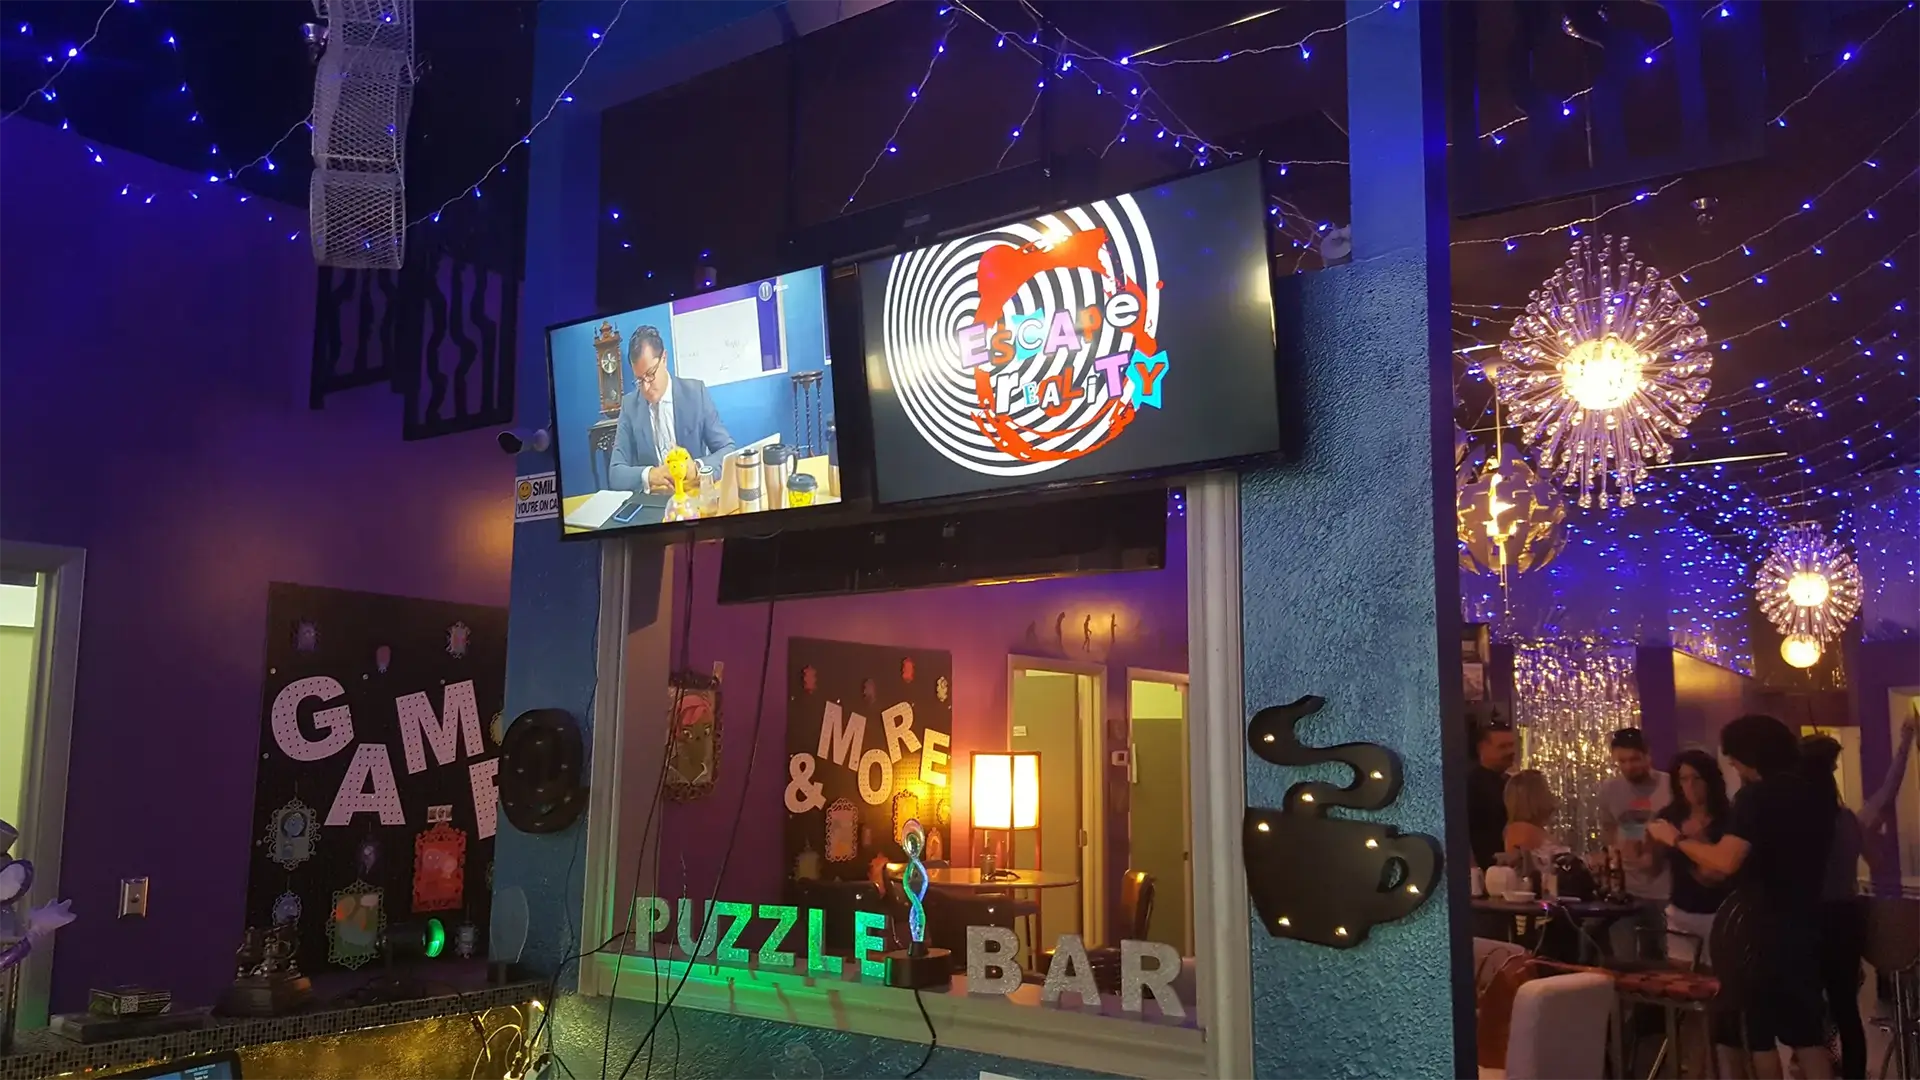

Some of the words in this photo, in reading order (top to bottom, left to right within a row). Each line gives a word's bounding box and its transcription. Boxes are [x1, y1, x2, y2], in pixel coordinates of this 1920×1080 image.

[517, 500, 539, 514] YOU'RE
[540, 499, 549, 511] ON
[784, 752, 827, 813] &
[817, 700, 950, 805] MORE
[635, 896, 885, 977] PUZZLE
[967, 925, 1186, 1017] BAR
